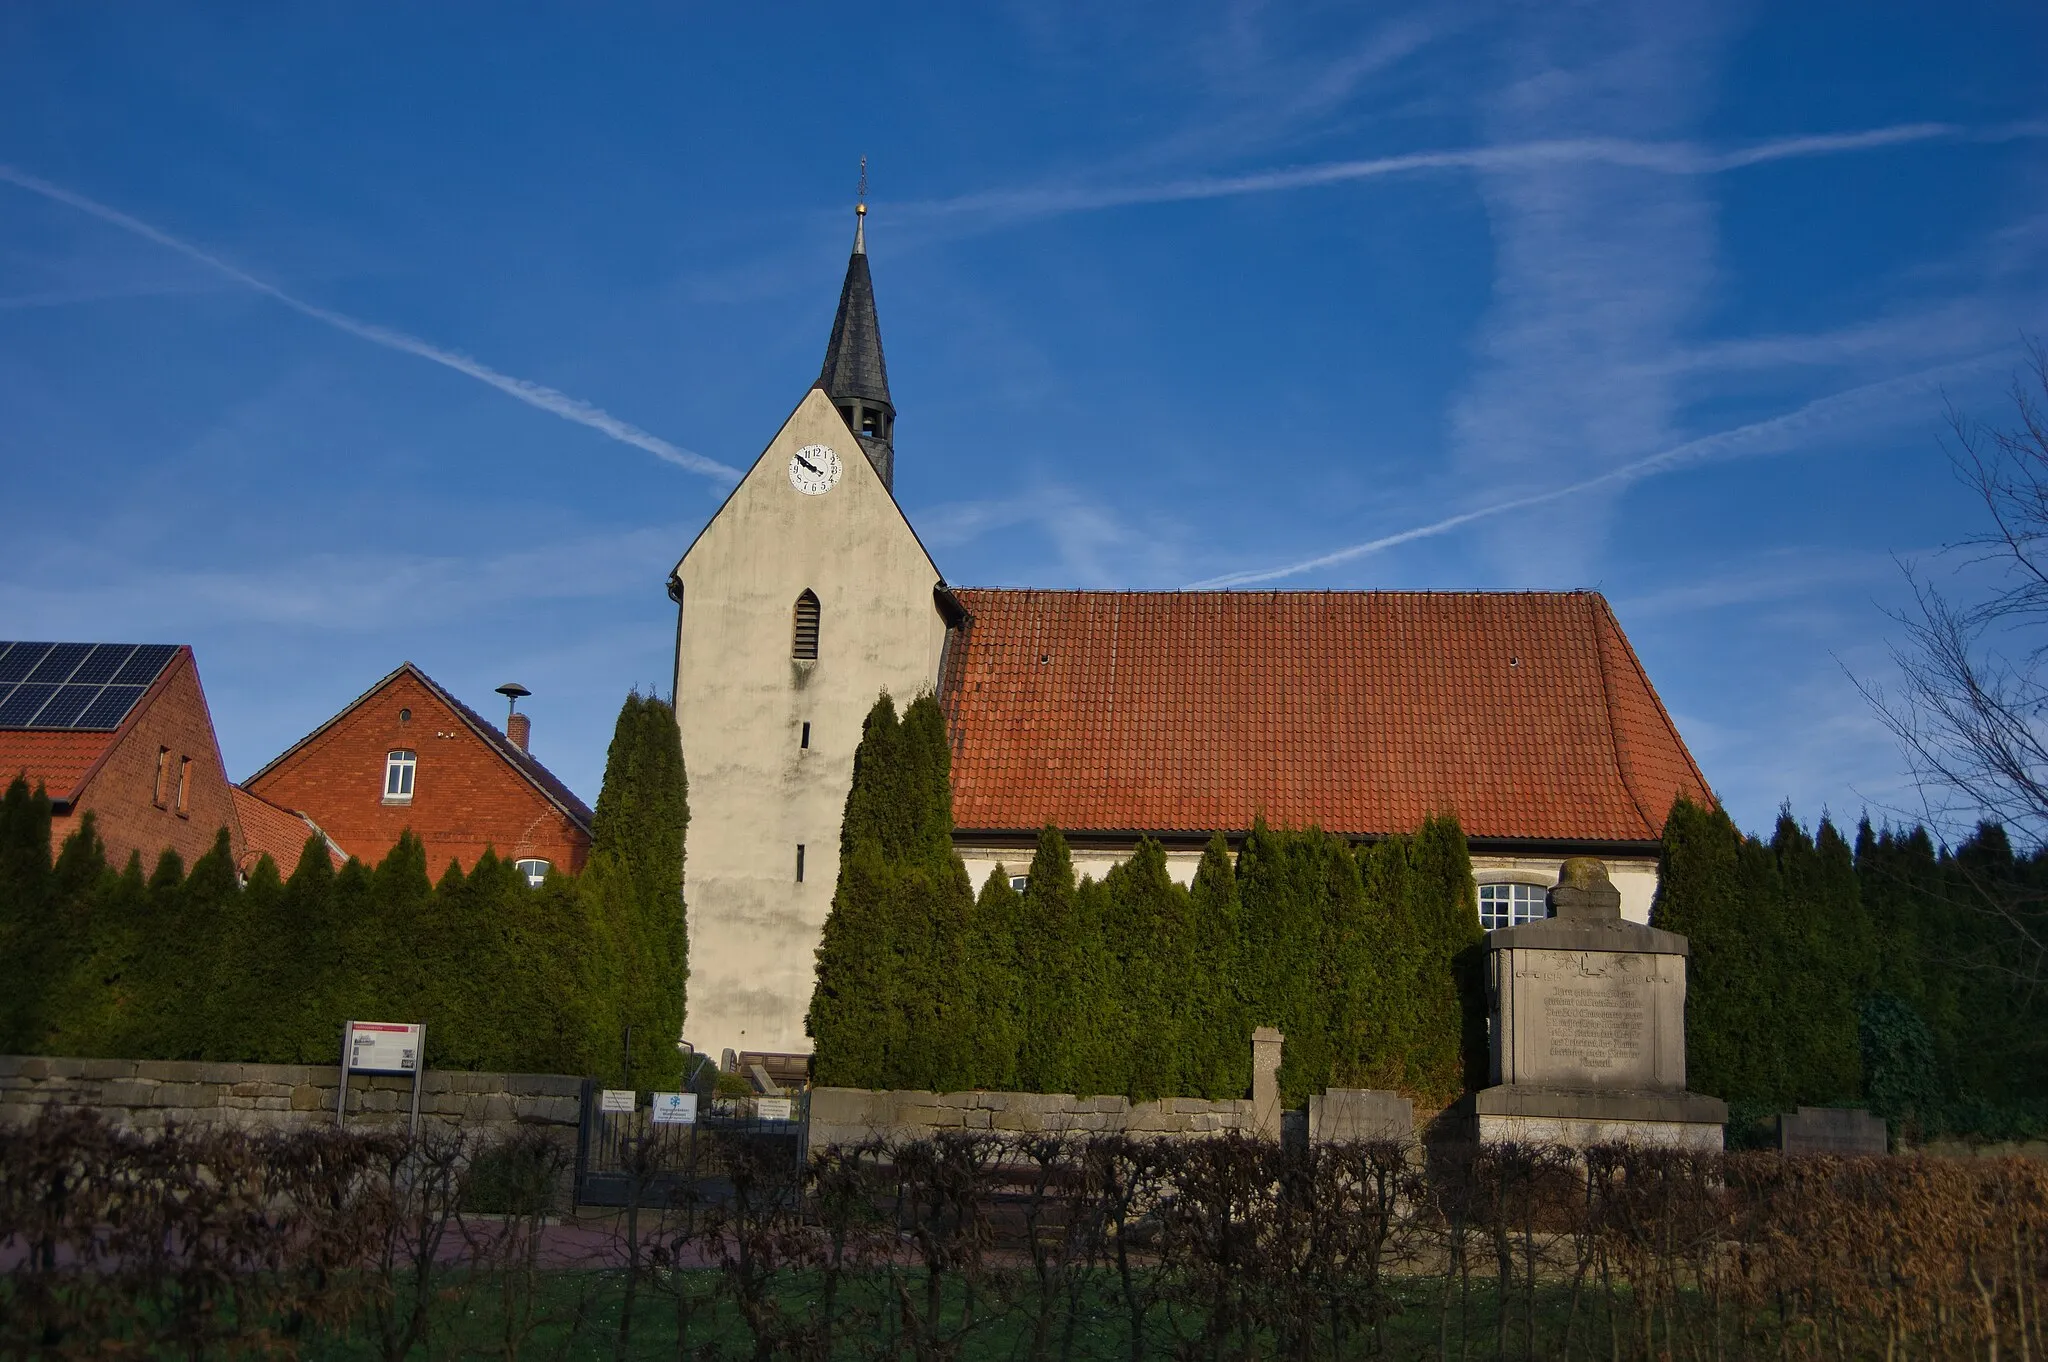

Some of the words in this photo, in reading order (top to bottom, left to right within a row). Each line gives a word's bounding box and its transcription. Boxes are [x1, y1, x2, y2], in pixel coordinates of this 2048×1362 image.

[805, 450, 810, 458] 11
[813, 448, 821, 457] 12
[830, 457, 836, 465] 2
[793, 466, 799, 474] 9
[831, 466, 838, 474] 3
[796, 474, 802, 483] 8
[828, 475, 834, 483] 4
[803, 481, 809, 490] 7
[812, 483, 817, 492] 6
[821, 482, 826, 490] 5
